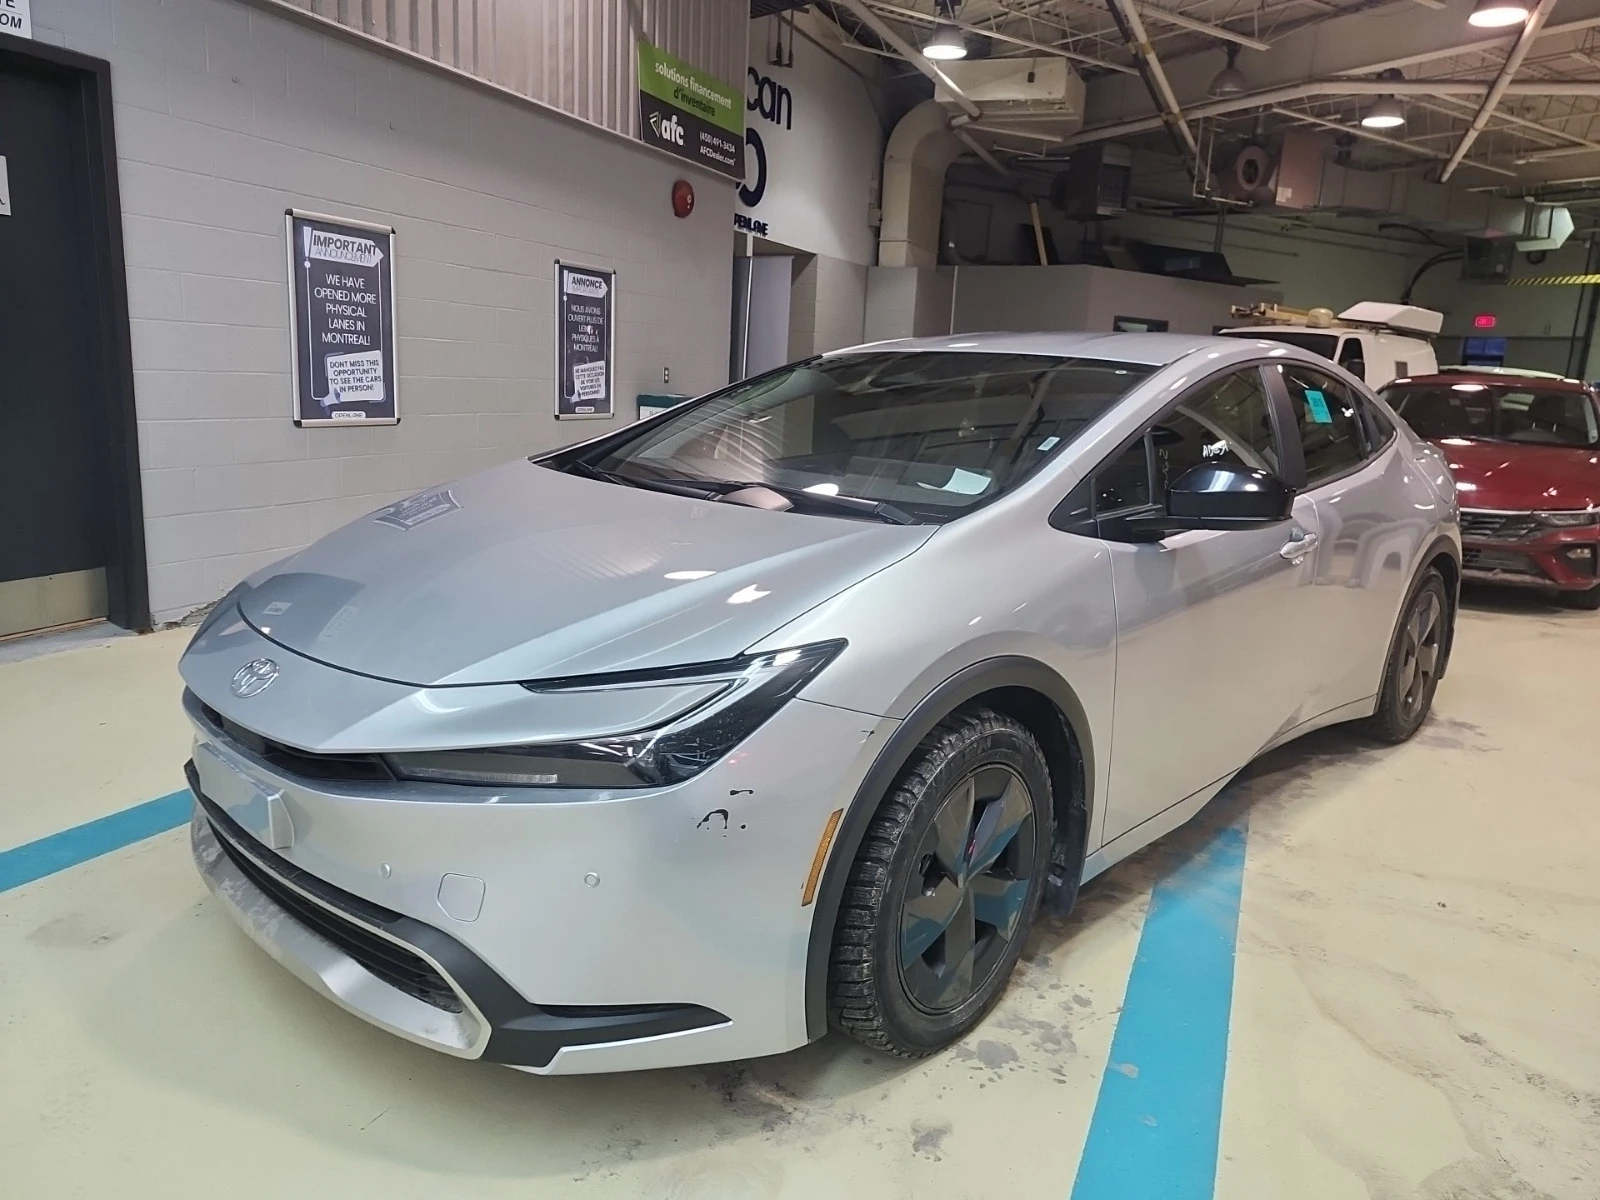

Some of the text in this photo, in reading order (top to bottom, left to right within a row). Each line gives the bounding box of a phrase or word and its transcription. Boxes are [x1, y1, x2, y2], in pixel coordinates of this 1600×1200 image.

[654, 62, 732, 109] solutions financement
[673, 87, 715, 116] d'inventaire
[661, 115, 684, 146] afc
[700, 131, 735, 153] (450) 491-3434
[313, 234, 377, 255] IMPORTANT
[315, 248, 372, 264] ANNOUNCEMENT
[326, 273, 365, 289] WE HAVE
[572, 276, 603, 289] ANNONCE
[314, 287, 376, 305] OPENED MORE
[326, 304, 367, 318] PHYSICAL
[571, 305, 601, 315] NOUS AVONS
[328, 319, 365, 331] LANES IN
[568, 314, 586, 322] OUVERT
[322, 333, 371, 346] MONTREAL!
[333, 368, 377, 377] OPPORTUNITY
[365, 376, 382, 384] CARS
[340, 384, 375, 393] IN PERSON!
